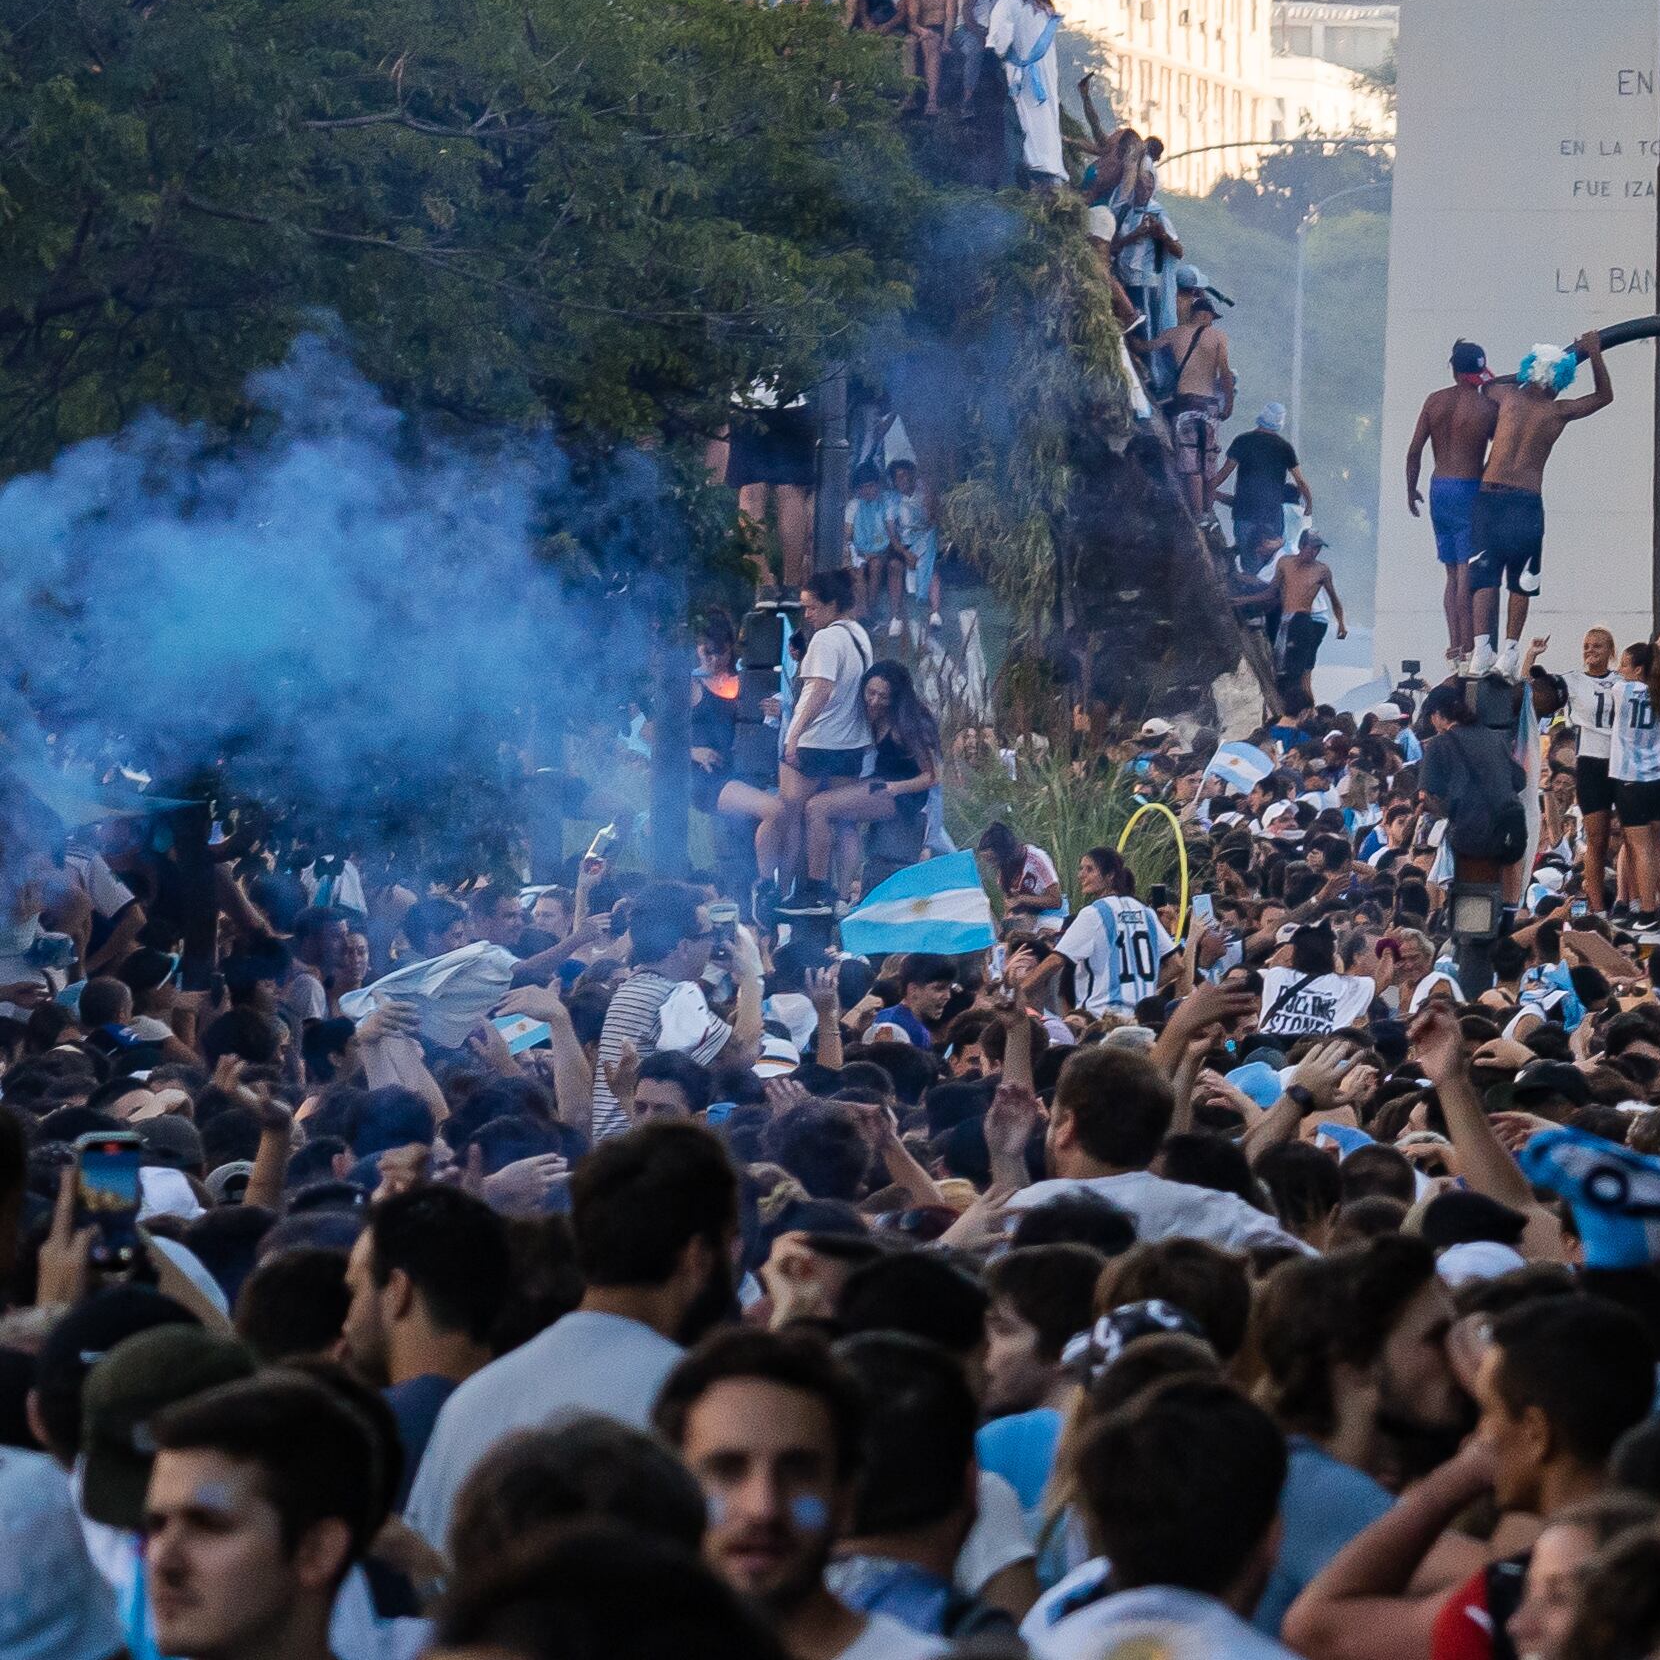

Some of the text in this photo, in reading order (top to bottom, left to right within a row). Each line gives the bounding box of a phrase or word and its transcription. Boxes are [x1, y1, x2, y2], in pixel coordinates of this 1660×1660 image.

[1618, 69, 1654, 95] EN
[1560, 140, 1585, 157] EN
[1600, 140, 1622, 157] LA
[1573, 181, 1611, 198] FUE
[1555, 267, 1590, 294] LA
[1115, 928, 1156, 983] 10
